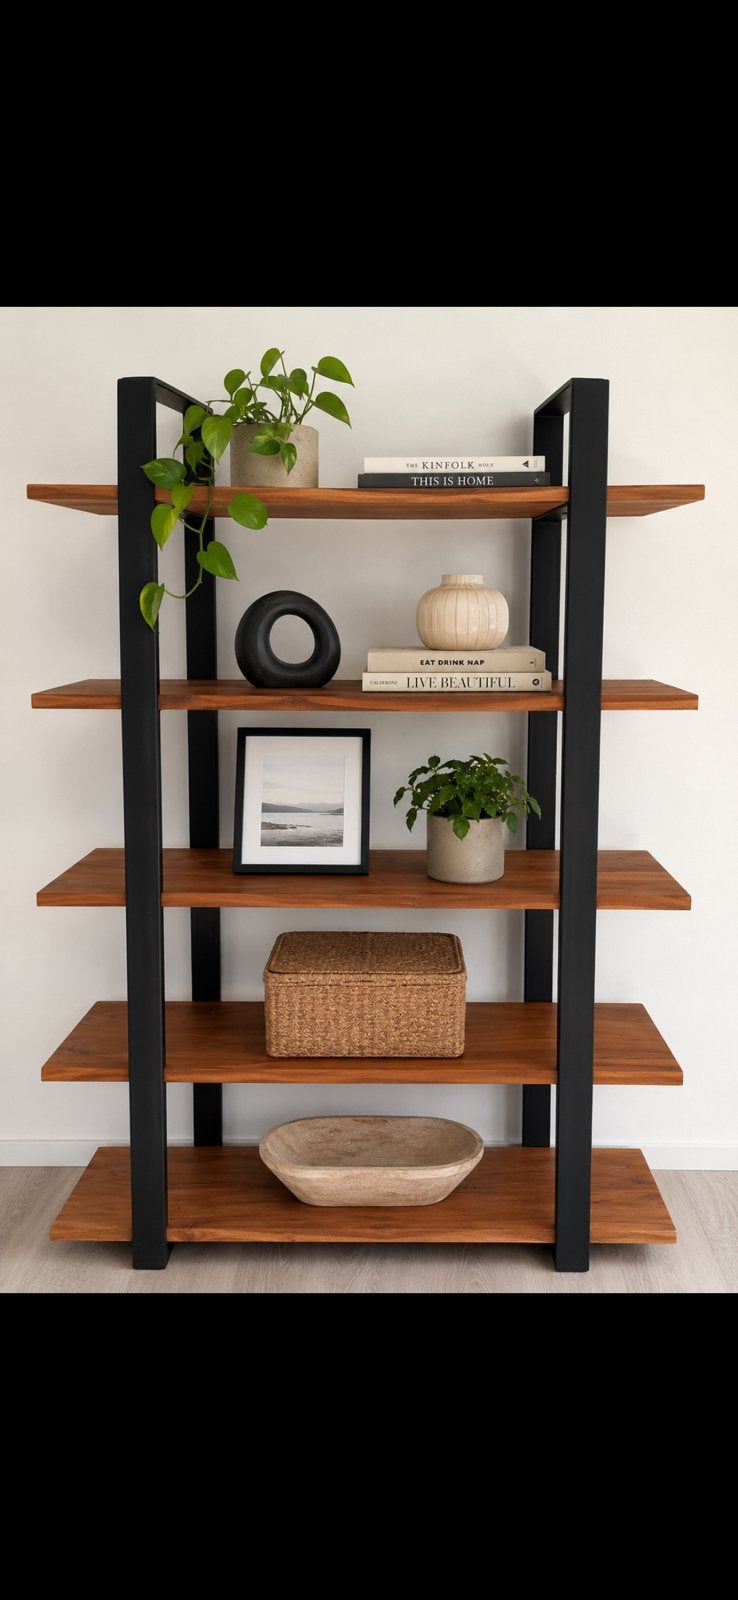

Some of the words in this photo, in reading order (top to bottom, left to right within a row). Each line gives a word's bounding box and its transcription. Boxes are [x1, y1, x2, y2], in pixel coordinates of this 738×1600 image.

[422, 461, 475, 469] KINFOLK
[411, 476, 440, 486] THIS
[443, 476, 454, 486] IS
[457, 476, 494, 486] HOME
[406, 677, 437, 688] LIVE
[441, 676, 516, 688] BEAUTIFUL
